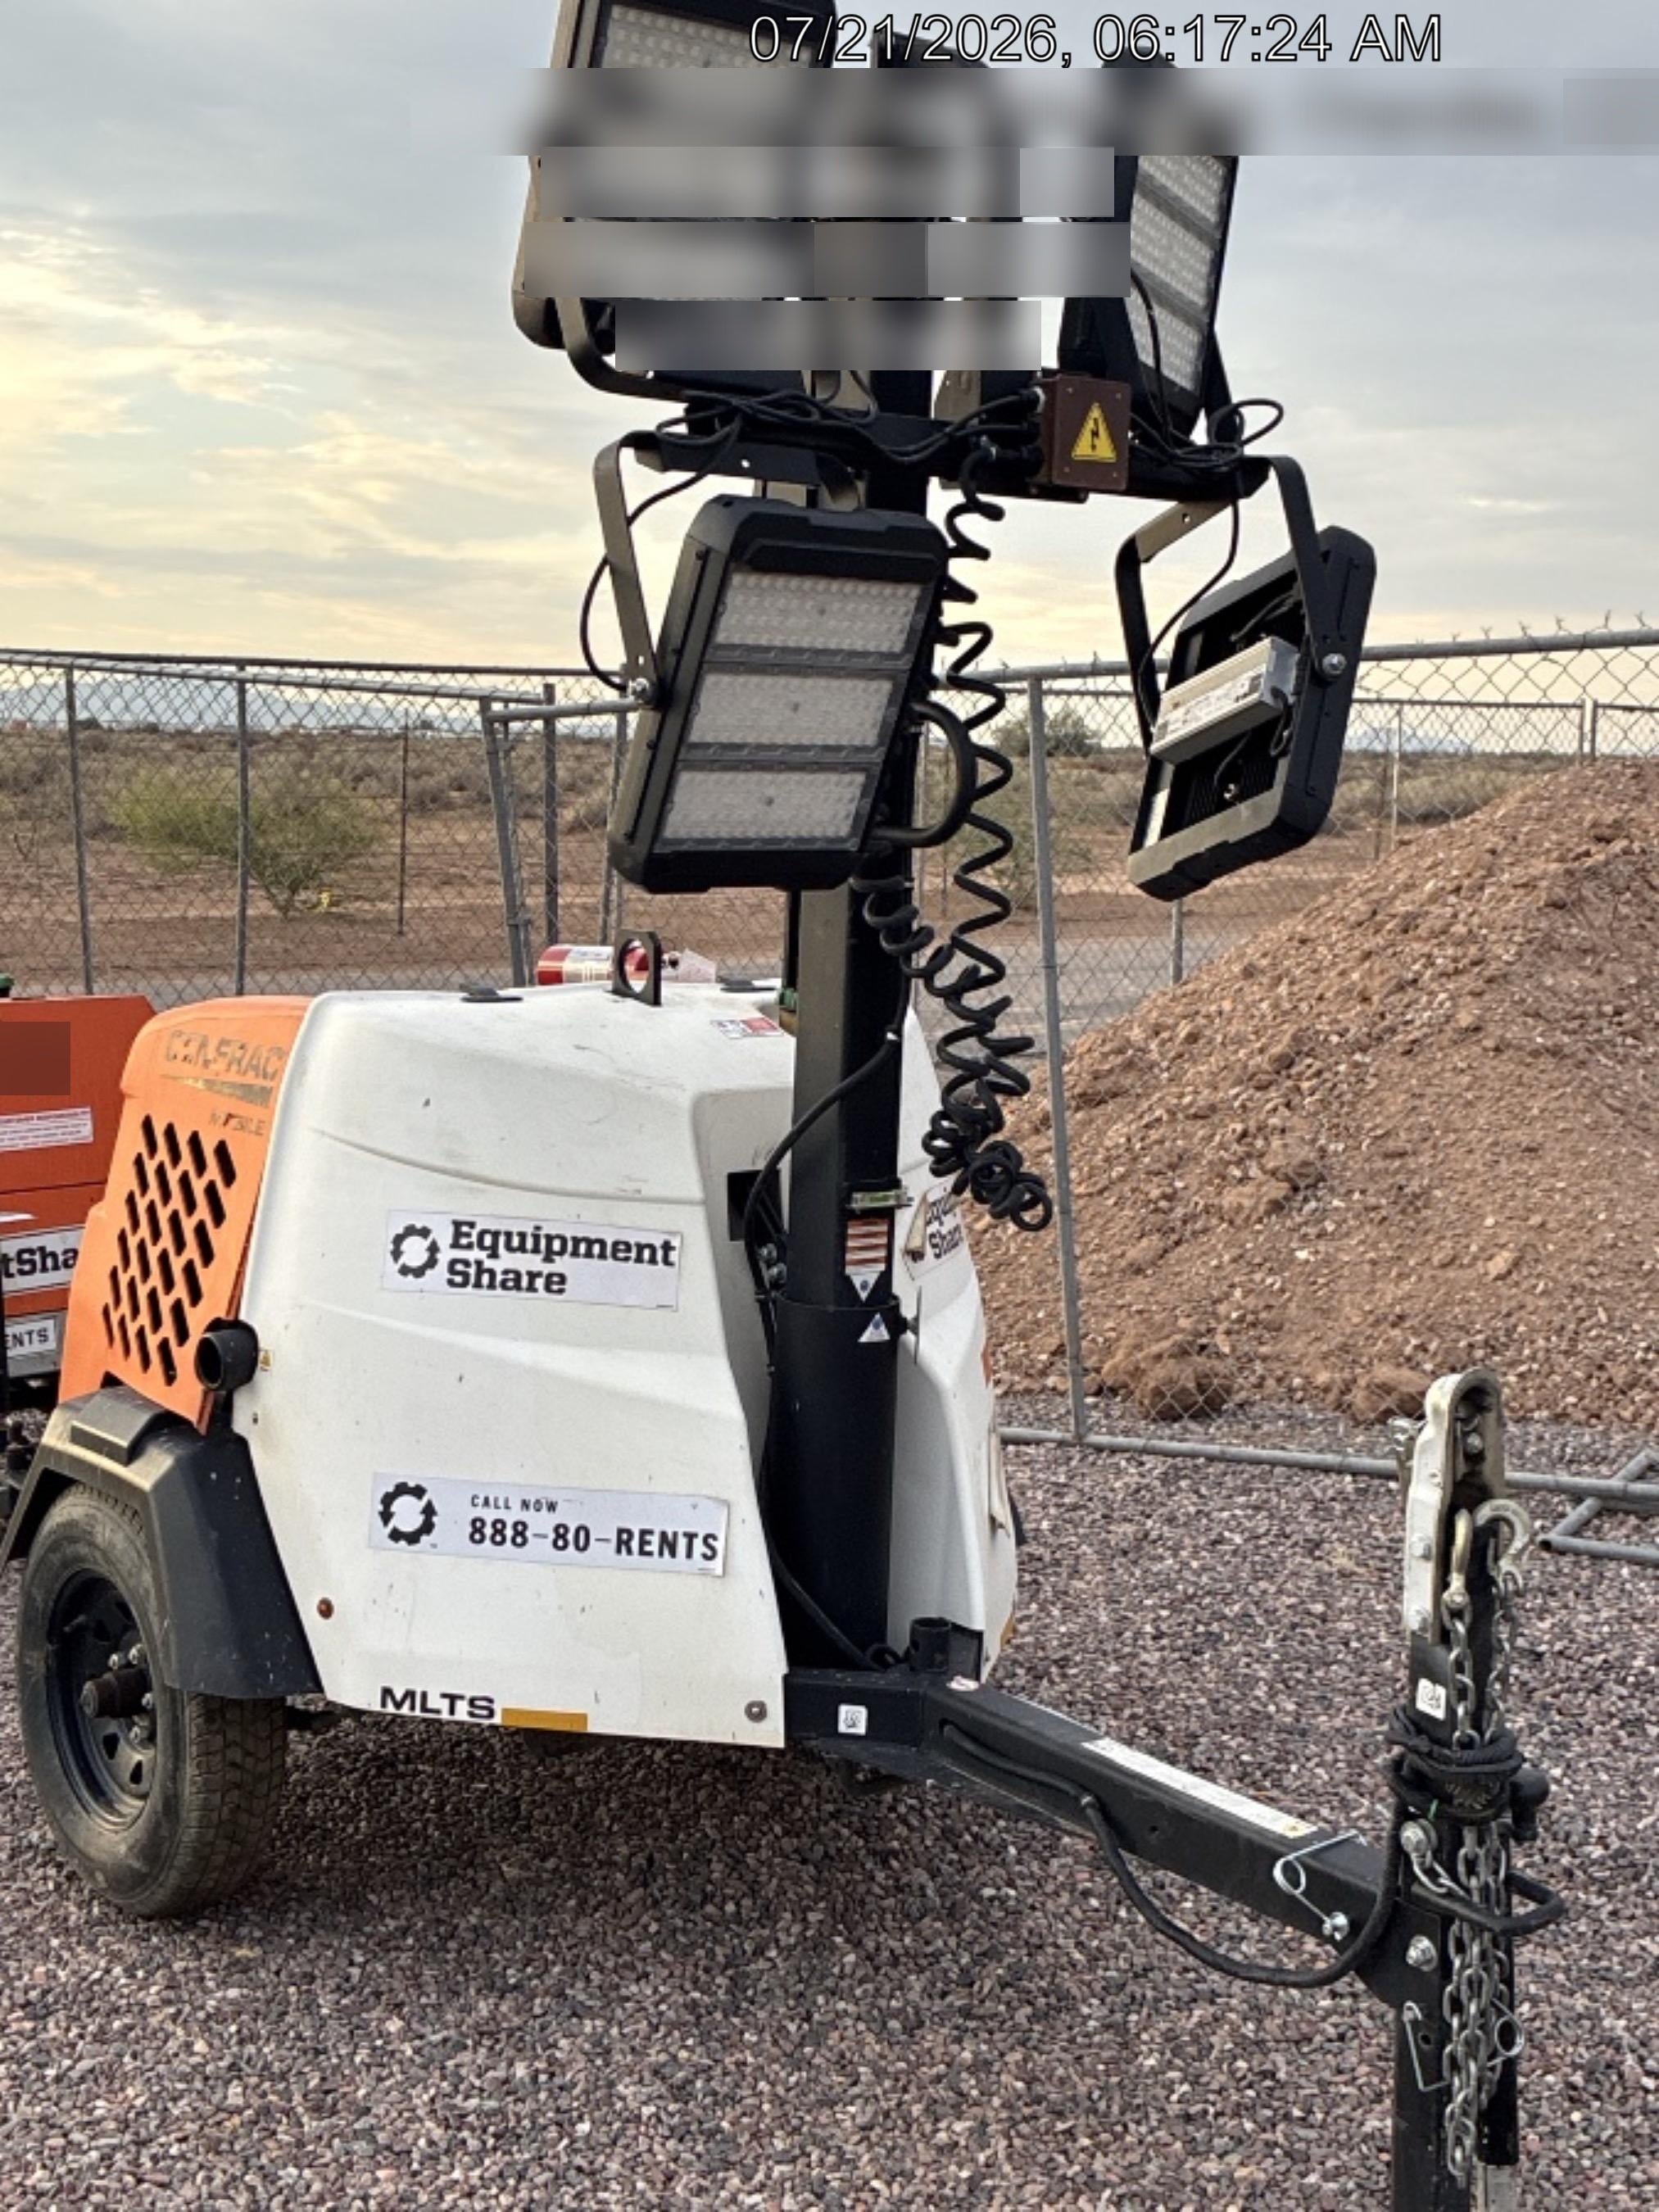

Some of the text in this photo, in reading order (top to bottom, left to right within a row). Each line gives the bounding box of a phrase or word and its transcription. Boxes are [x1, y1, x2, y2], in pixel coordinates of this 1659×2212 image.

[448, 1219, 677, 1267] Equipment
[446, 1258, 568, 1294] Share
[470, 1494, 559, 1513] CALL NOW
[469, 1516, 719, 1562] 888-80-RENTS
[380, 1685, 495, 1720] MLTS
